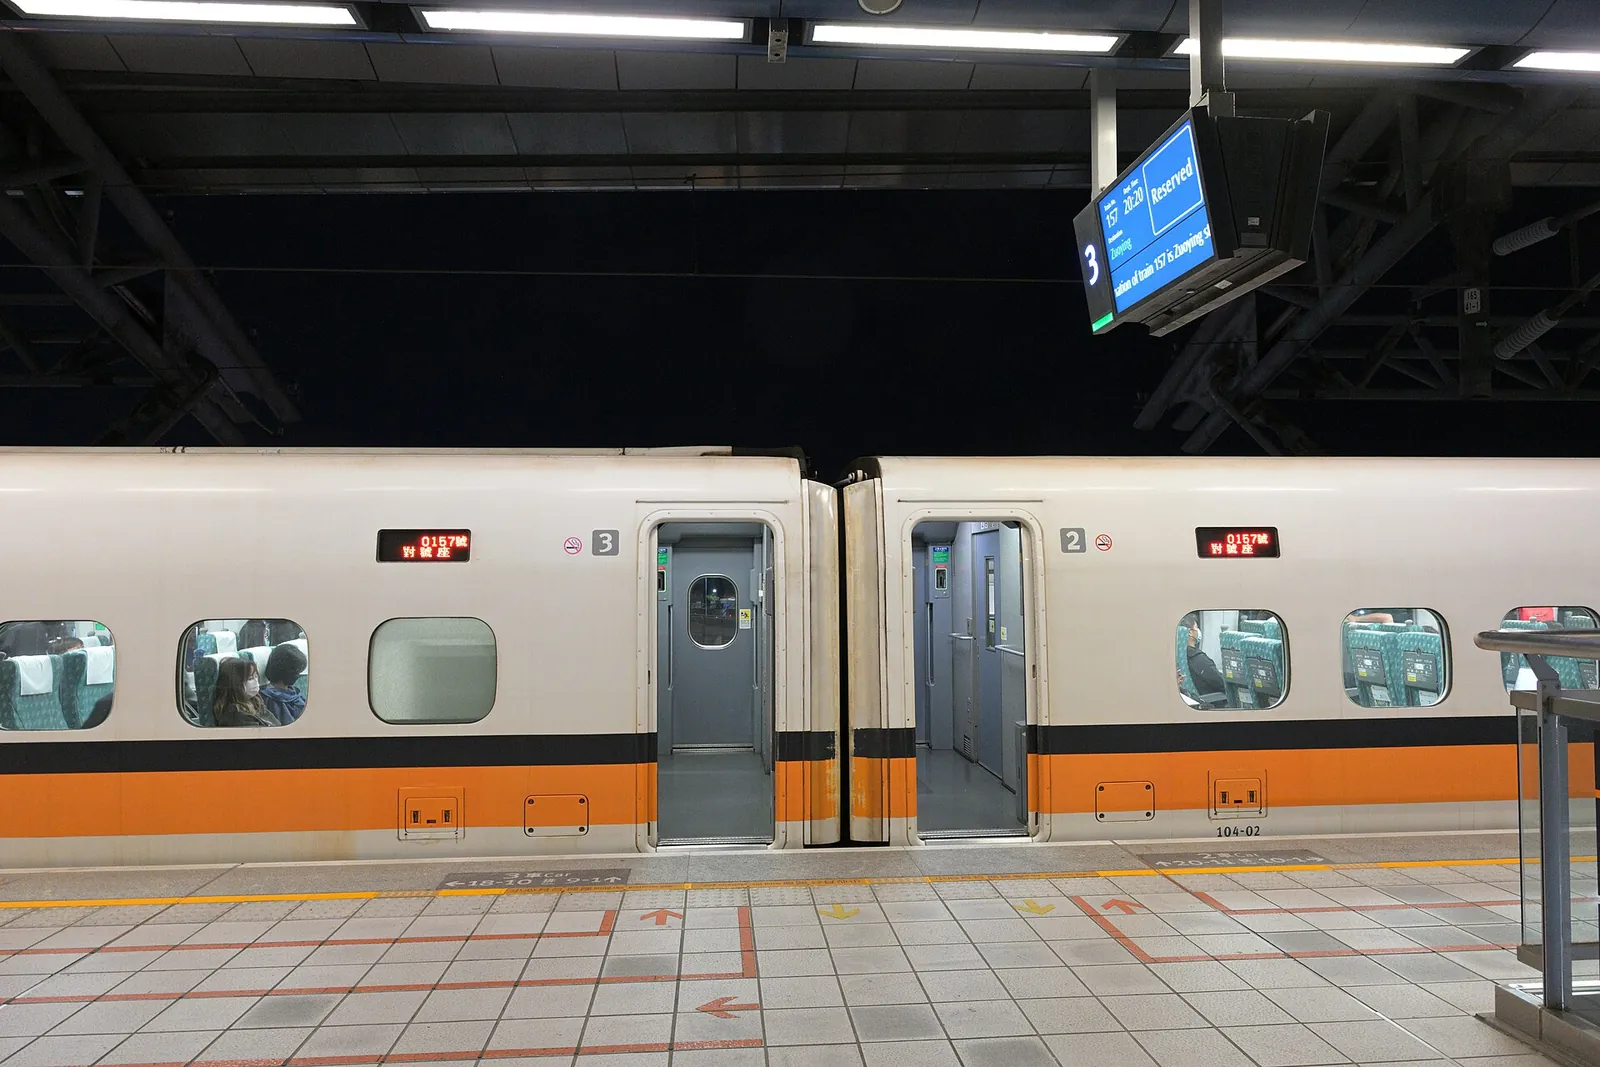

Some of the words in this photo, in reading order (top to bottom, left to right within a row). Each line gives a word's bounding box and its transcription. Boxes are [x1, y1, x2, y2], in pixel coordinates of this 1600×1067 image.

[1151, 156, 1193, 205] Reserved
[1122, 186, 1144, 215] 20:20
[1106, 207, 1118, 229] 157
[1110, 237, 1133, 260] Zuoying
[1131, 270, 1139, 287] of
[1138, 263, 1154, 281] train
[1153, 252, 1166, 271] 157
[1166, 249, 1174, 263] is
[1173, 232, 1205, 259] Zuoying
[1084, 244, 1099, 286] 3
[599, 532, 613, 553] 3
[1066, 531, 1081, 550] 2
[1216, 826, 1260, 837] 104-02
[502, 872, 521, 880] 3
